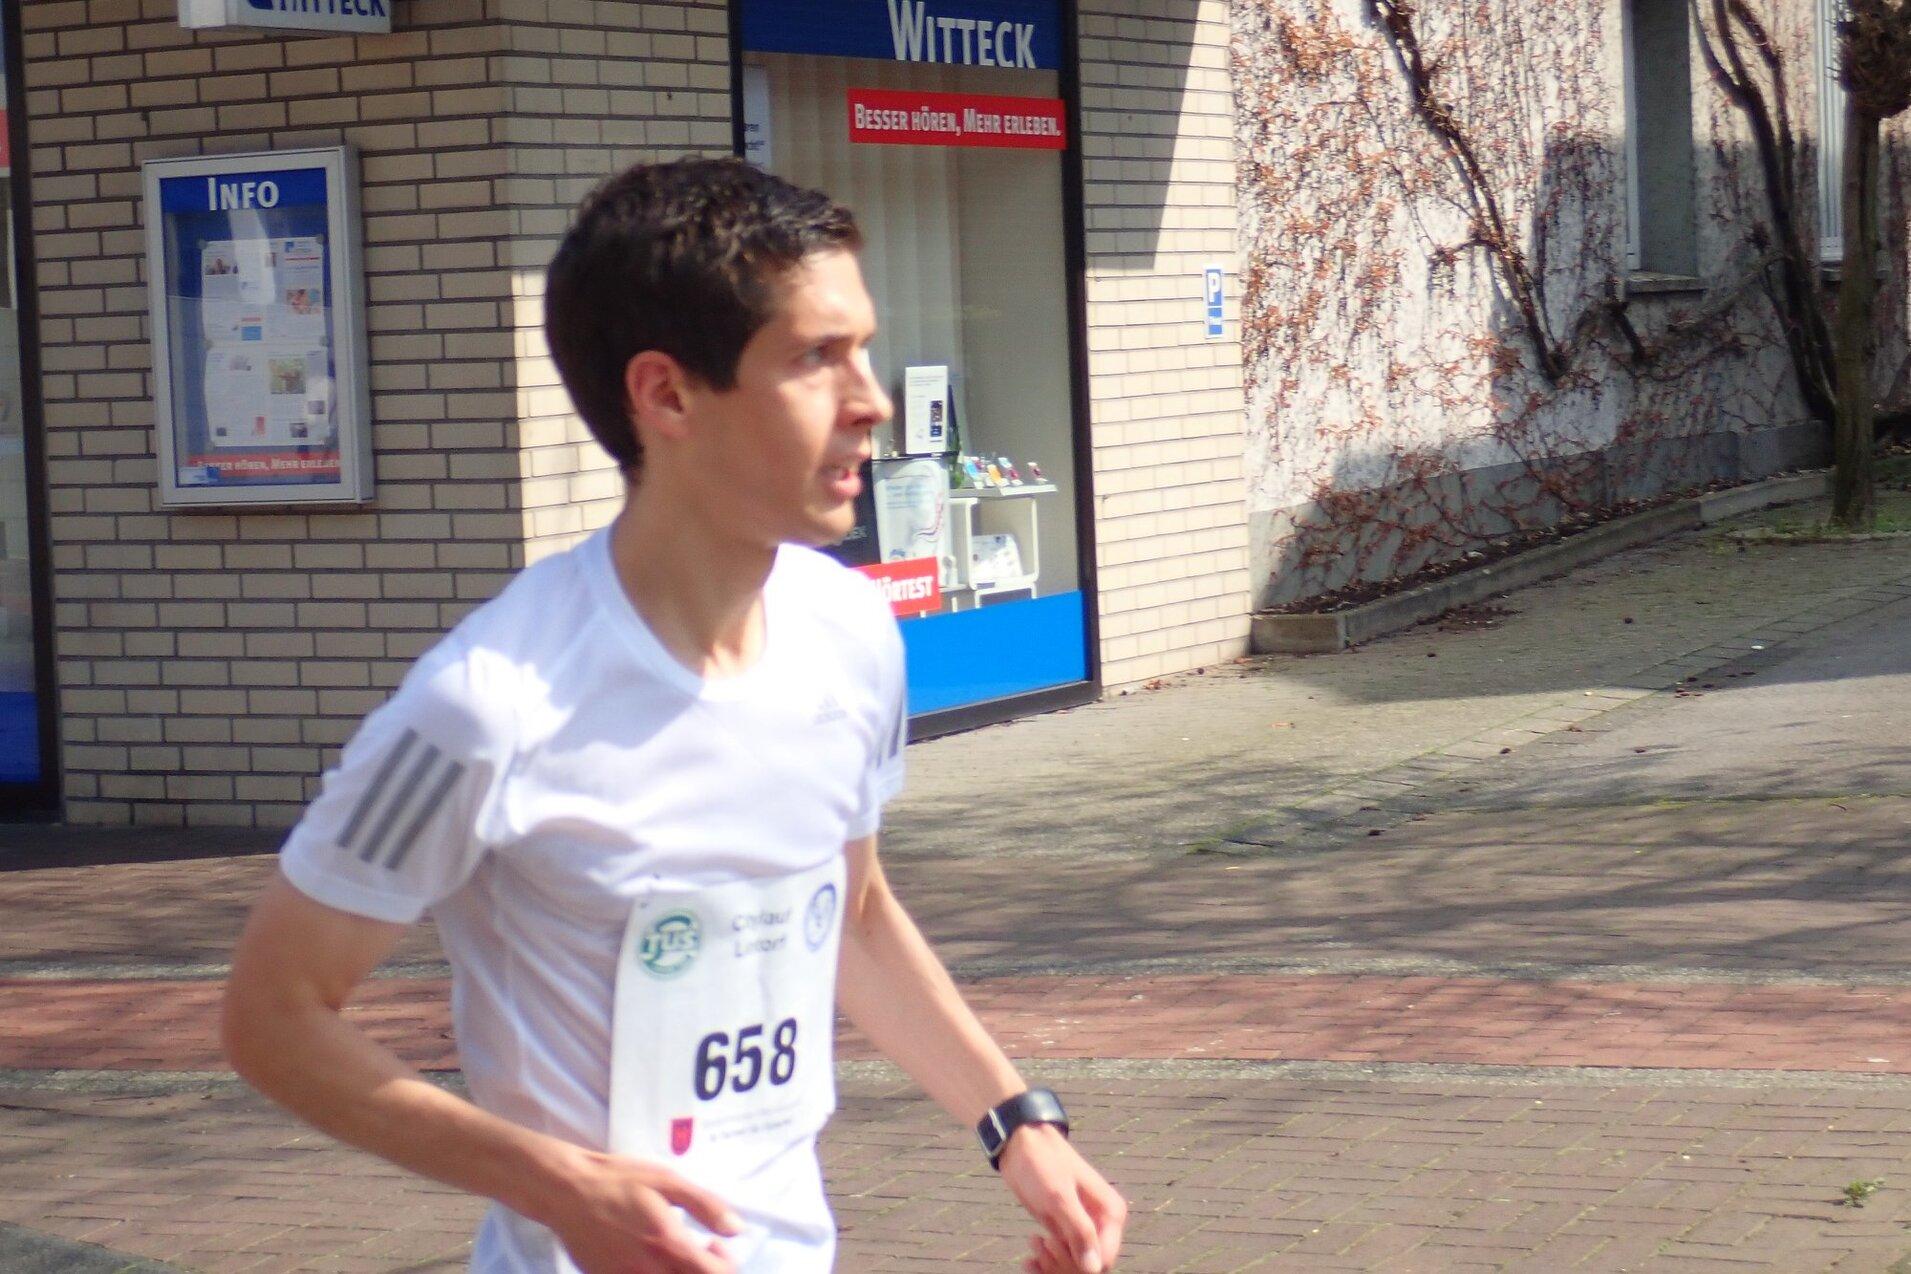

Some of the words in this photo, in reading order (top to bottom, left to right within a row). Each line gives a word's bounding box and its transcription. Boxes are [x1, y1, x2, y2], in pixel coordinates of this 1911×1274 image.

[887, 0, 1036, 69] WITTECK
[854, 103, 908, 130] BESSER
[911, 106, 961, 136] HÖREN,
[963, 108, 1001, 133] MEHR
[1004, 115, 1062, 136] ERLEBEN.
[208, 177, 279, 211] INFO
[1208, 272, 1221, 303] P
[694, 1017, 797, 1101] 658
